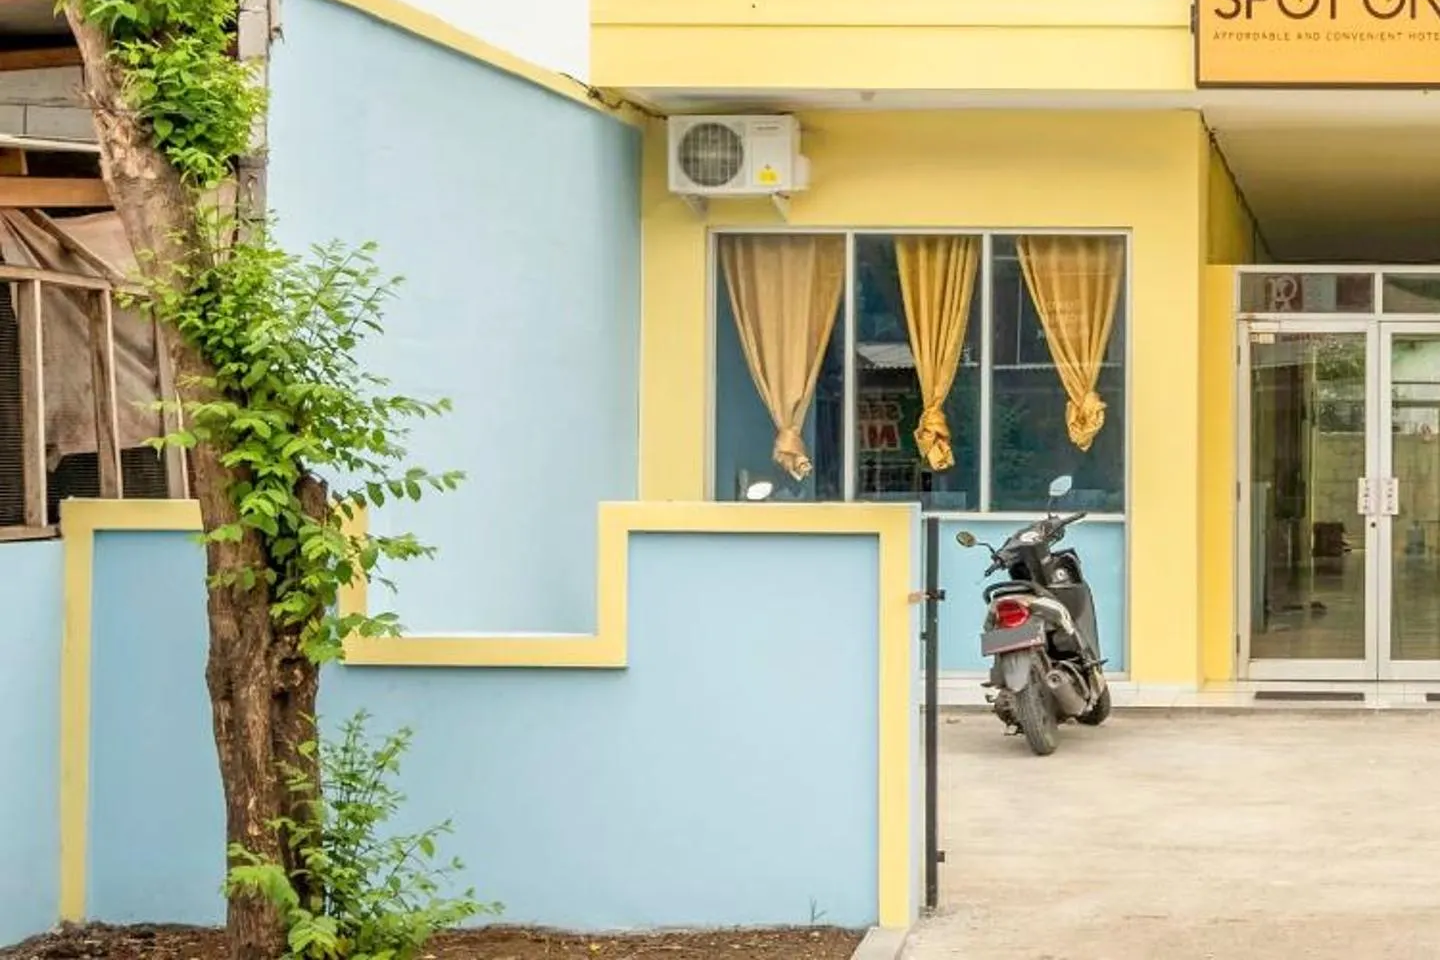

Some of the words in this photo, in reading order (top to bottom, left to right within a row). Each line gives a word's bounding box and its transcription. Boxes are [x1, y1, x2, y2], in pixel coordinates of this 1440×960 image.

[1213, 31, 1290, 42] AFFORDABLE
[1297, 31, 1320, 42] AND
[1326, 31, 1403, 42] CONVENIENT
